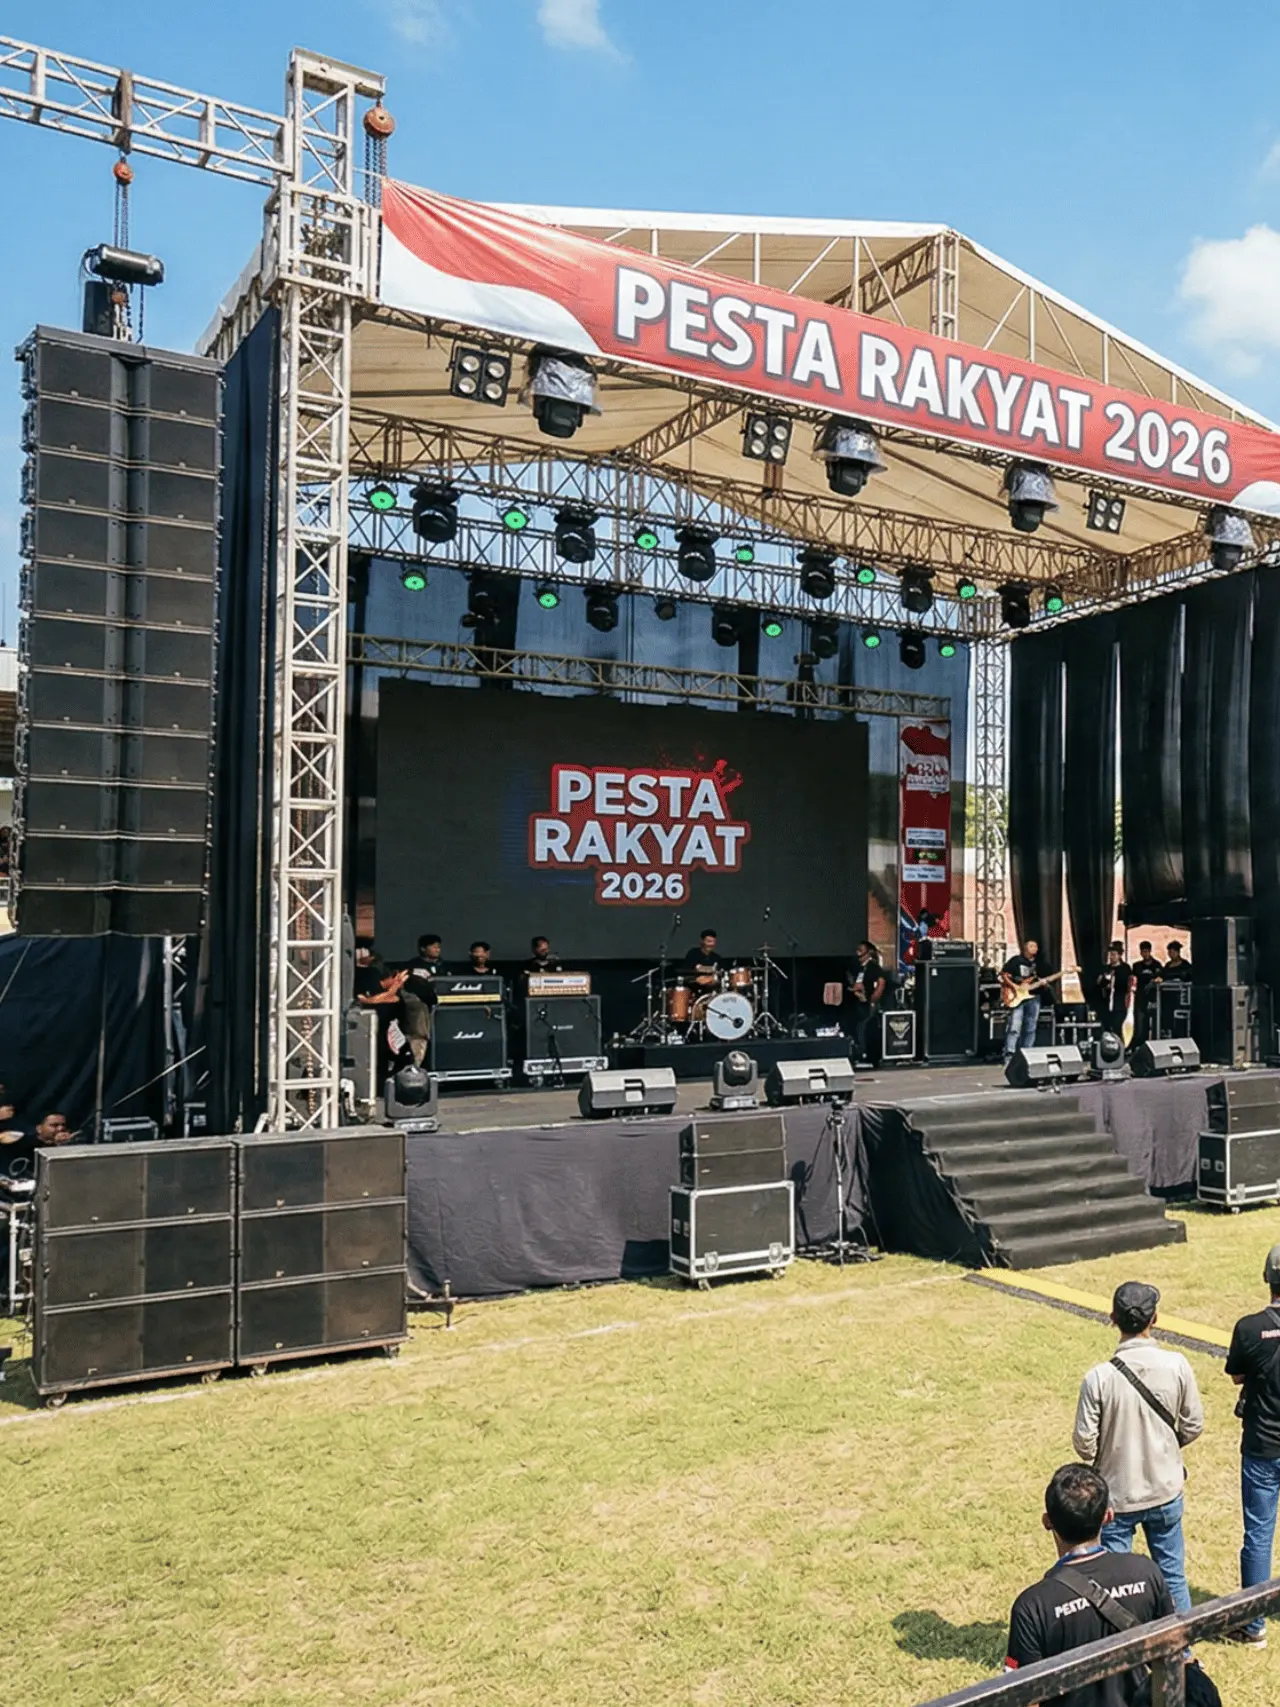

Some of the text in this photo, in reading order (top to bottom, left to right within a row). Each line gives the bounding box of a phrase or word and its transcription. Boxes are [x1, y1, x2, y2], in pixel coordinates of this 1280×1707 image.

[615, 266, 1231, 485] PESTA RAKYAT 2026
[558, 770, 725, 819] PESTA
[534, 819, 745, 866] RAKYAT
[602, 872, 684, 899] 2026
[1055, 1598, 1090, 1618] PESTA
